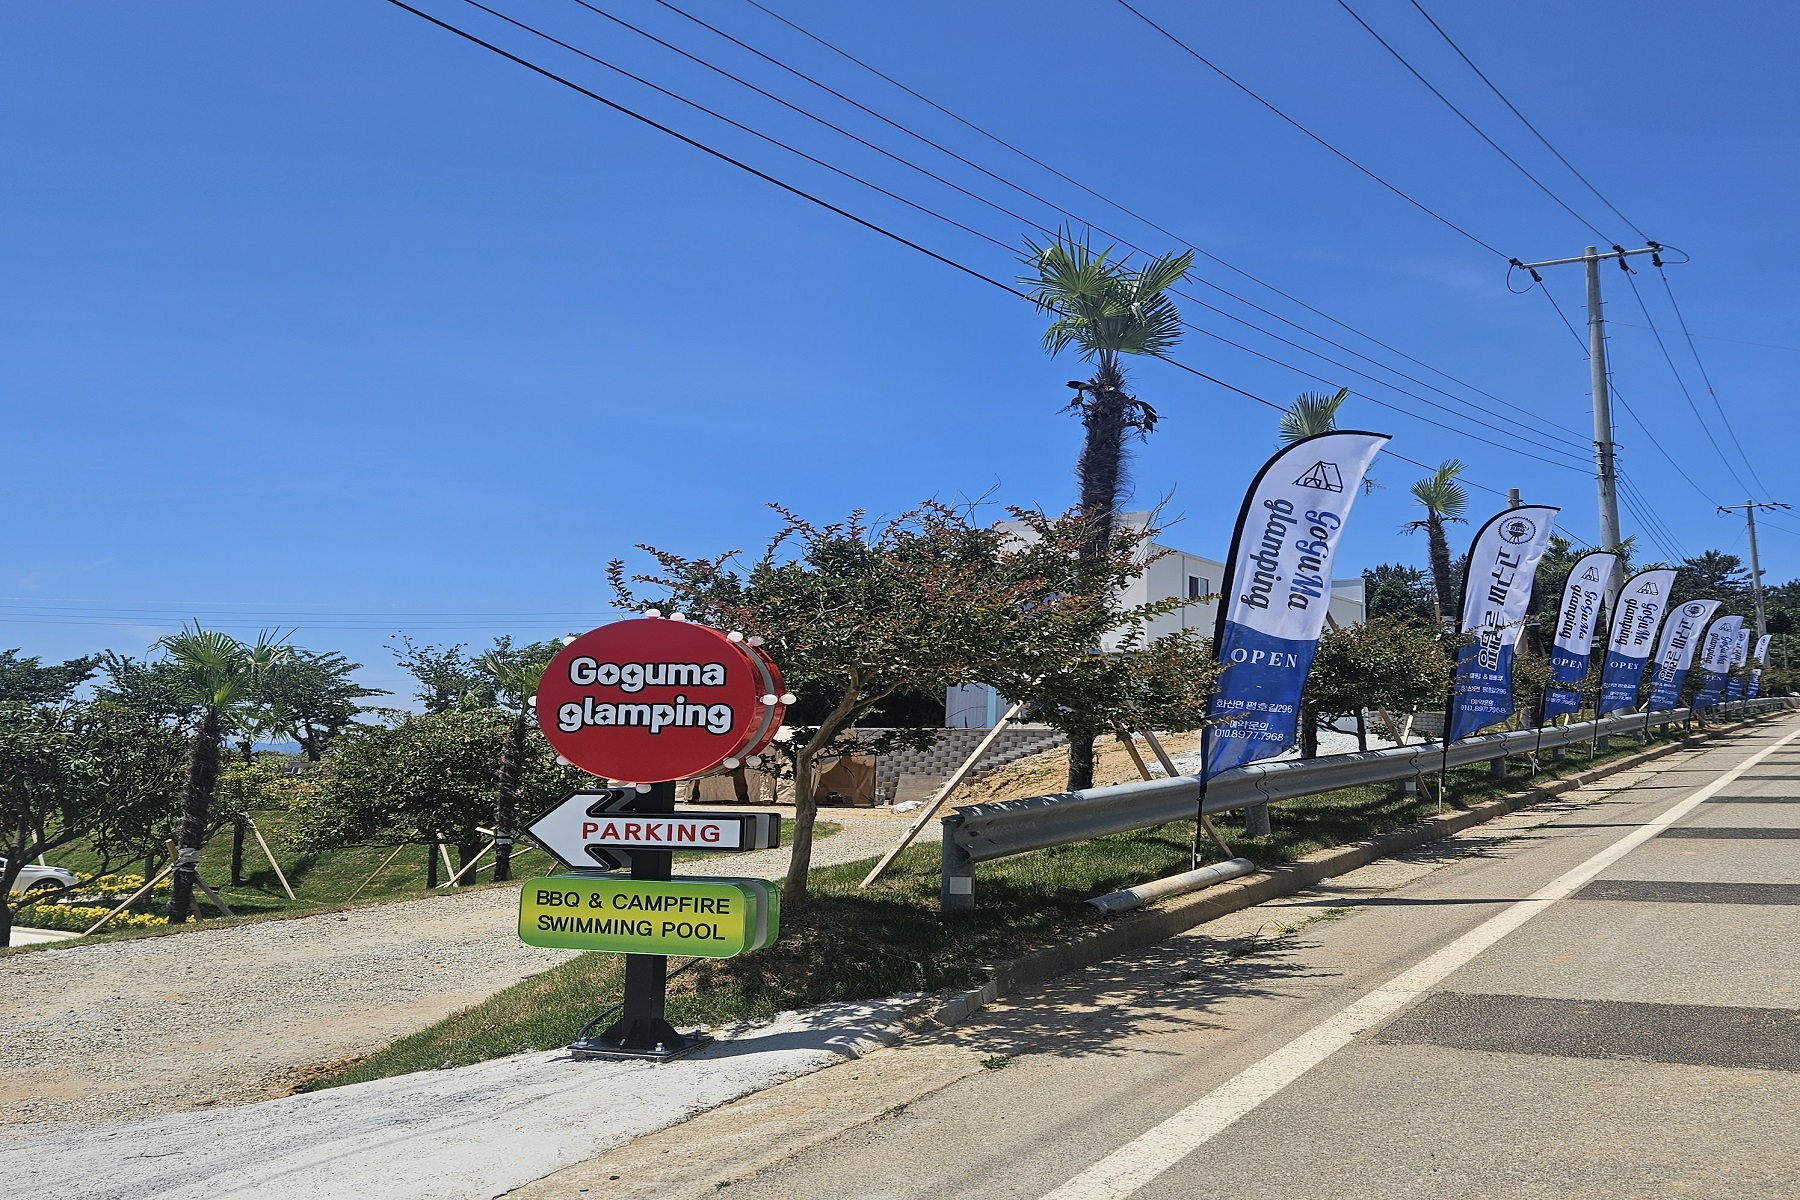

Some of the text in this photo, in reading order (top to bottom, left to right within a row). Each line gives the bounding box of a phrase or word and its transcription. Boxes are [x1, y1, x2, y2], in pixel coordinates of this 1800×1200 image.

[1240, 498, 1298, 610] glamping
[1488, 546, 1521, 606] 고구마
[1559, 584, 1581, 640] glamping
[1615, 598, 1638, 646] glamping
[1478, 611, 1504, 672] 글램핑
[1671, 617, 1694, 650] 고구마
[1704, 632, 1720, 664] glamping
[569, 656, 726, 693] Goguma
[1230, 648, 1298, 668] OPEN
[1658, 650, 1682, 682] 글램핑
[557, 694, 734, 735] glamping
[1214, 729, 1284, 742] 010.8977.7968
[582, 822, 720, 842] PARKING
[536, 889, 730, 915] BBQ & CAMPFIRE
[537, 914, 726, 940] SWIMMING POOL
